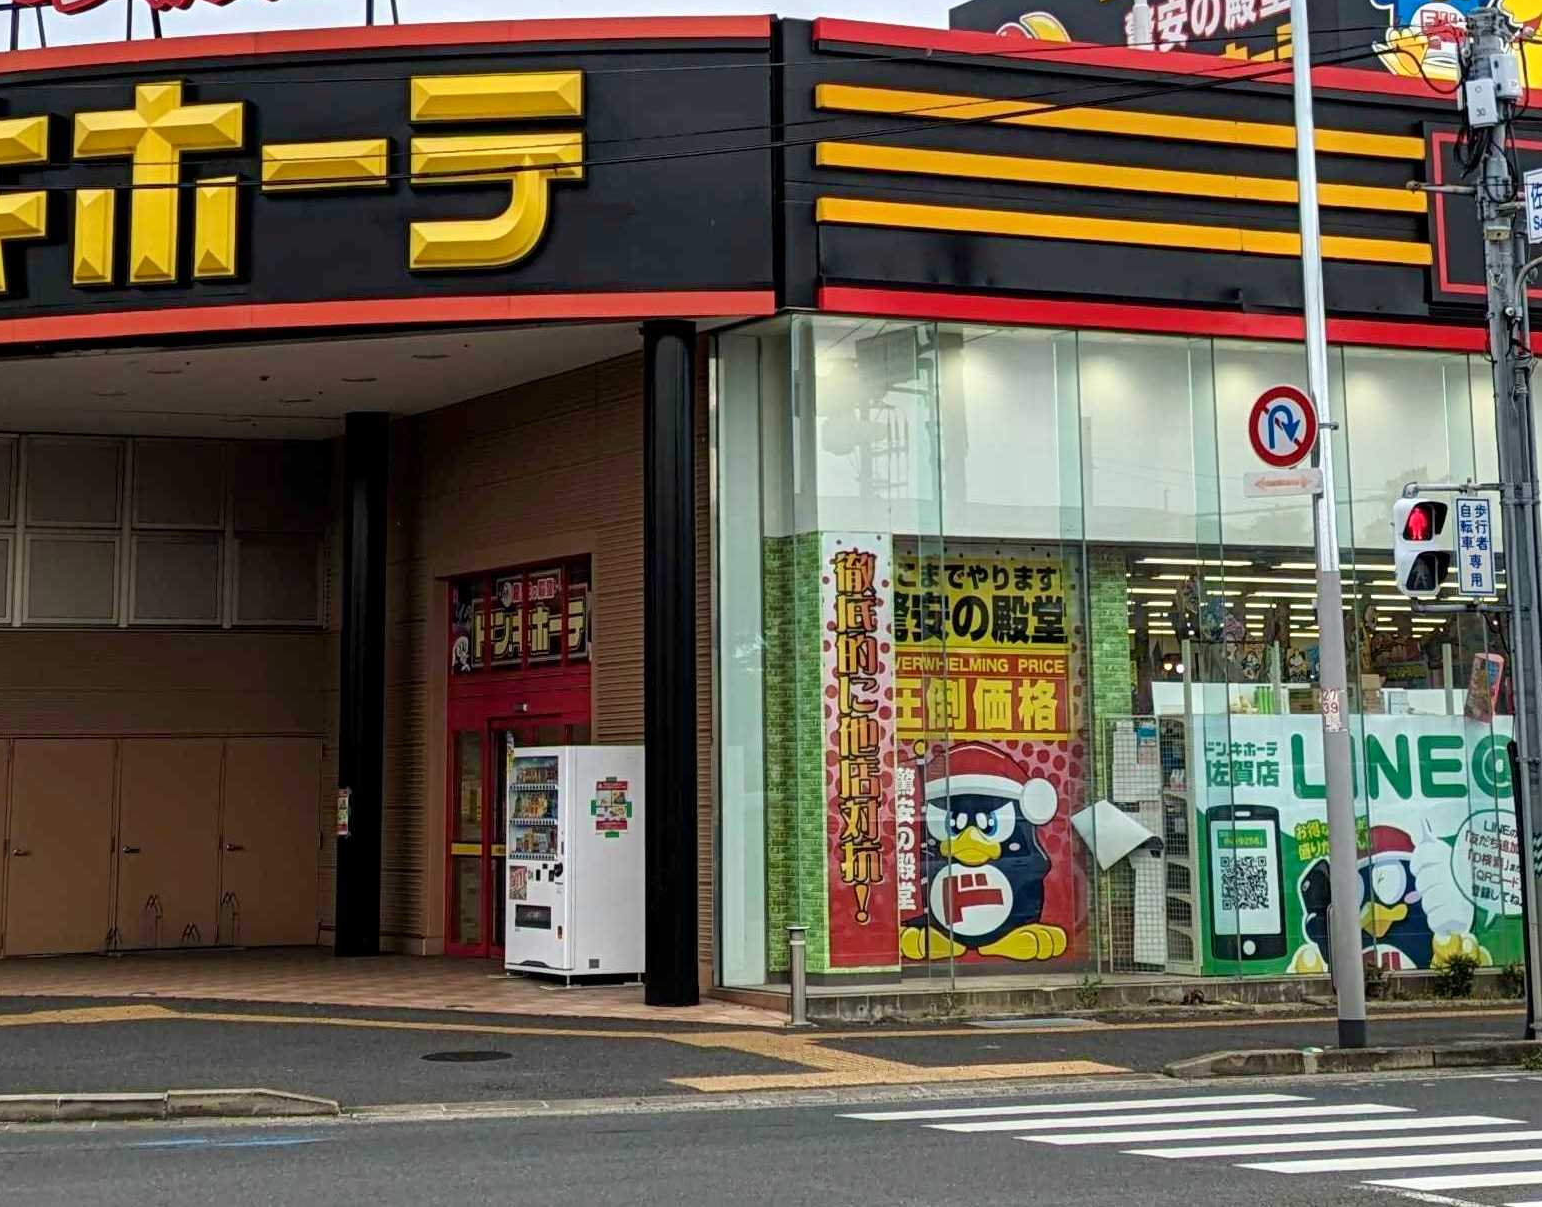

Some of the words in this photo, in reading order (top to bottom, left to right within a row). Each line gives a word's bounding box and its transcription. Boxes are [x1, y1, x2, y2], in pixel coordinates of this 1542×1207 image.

[1460, 504, 1474, 550] 自転車
[1474, 504, 1488, 551] 歩行者
[1470, 554, 1484, 588] 専用
[1018, 658, 1066, 674] PRICE
